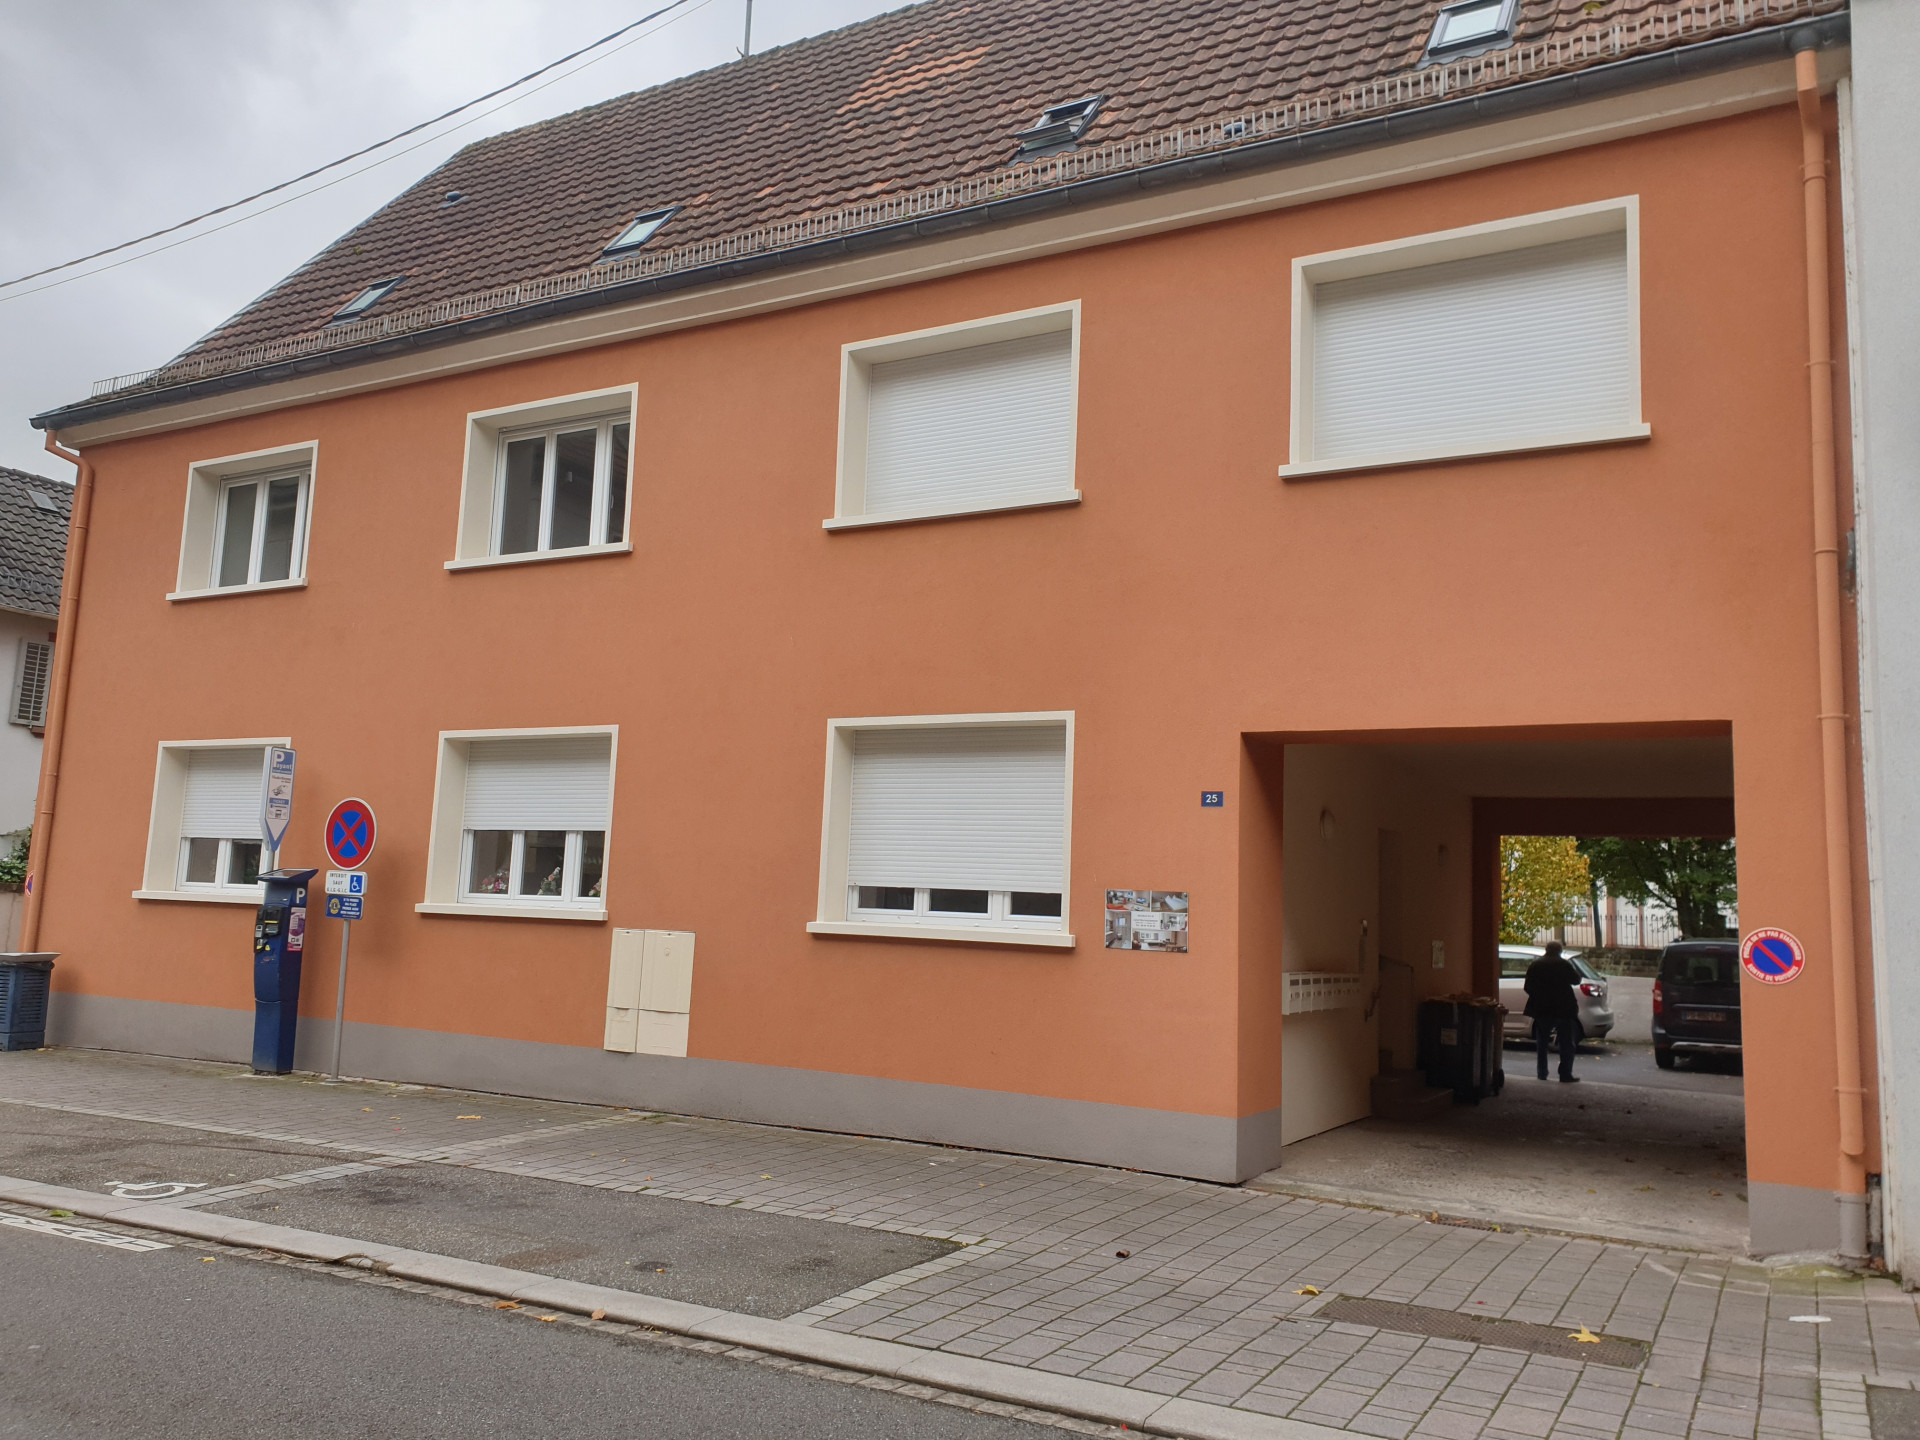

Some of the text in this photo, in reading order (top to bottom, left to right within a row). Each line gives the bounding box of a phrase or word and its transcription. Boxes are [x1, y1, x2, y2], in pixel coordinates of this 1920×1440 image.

[1205, 794, 1218, 803] 25
[296, 887, 306, 904] P
[1747, 964, 1765, 980] SORTIE
